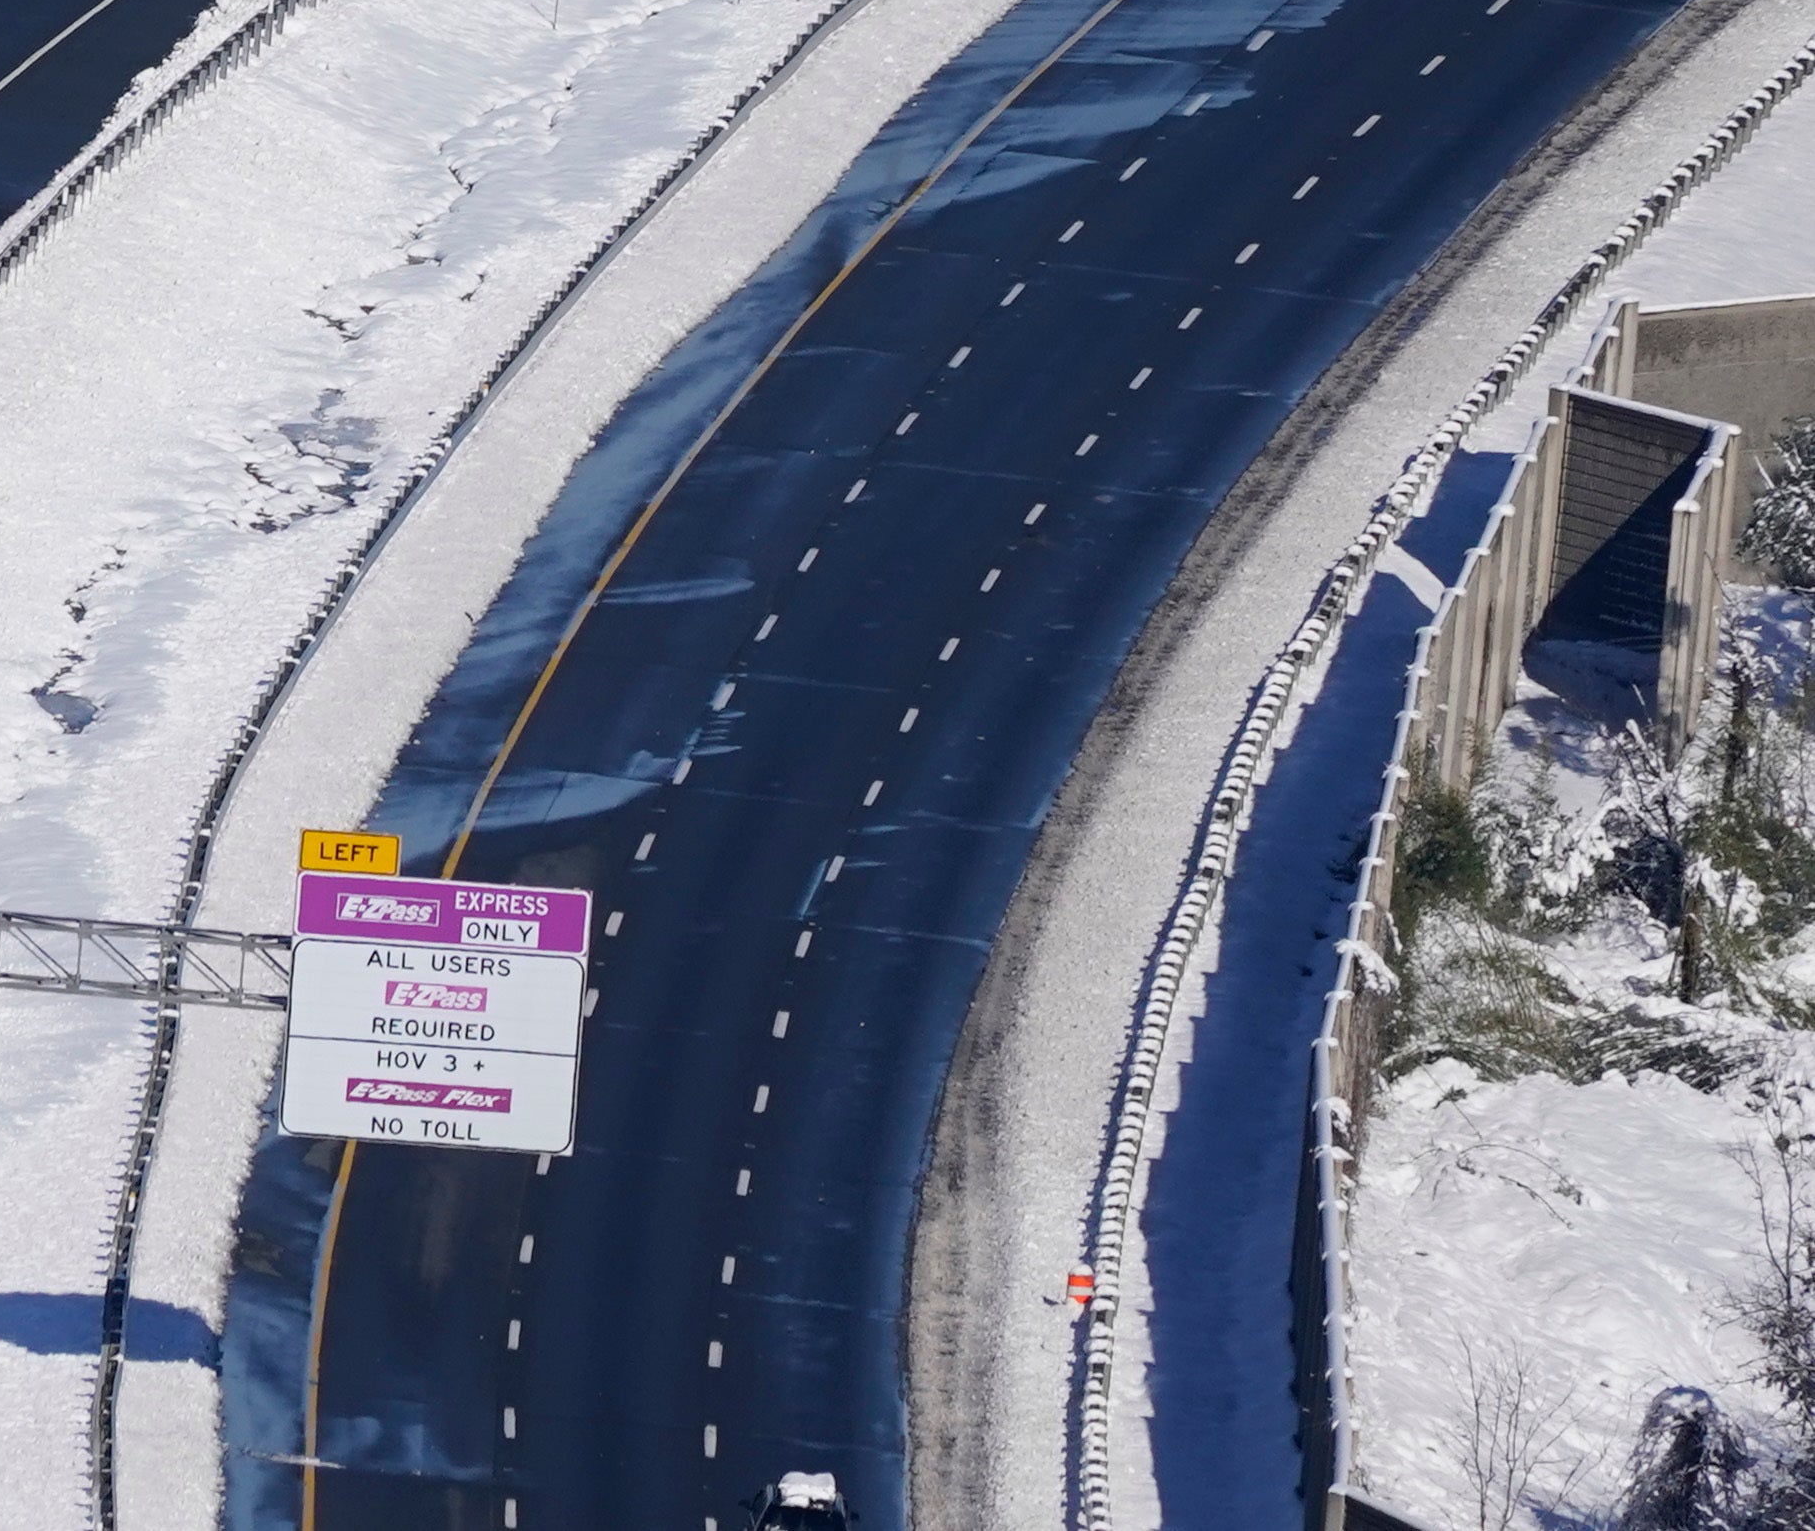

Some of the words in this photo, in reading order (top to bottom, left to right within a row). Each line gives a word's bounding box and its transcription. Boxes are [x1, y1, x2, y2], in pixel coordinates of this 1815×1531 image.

[319, 843, 379, 863] LEFT
[340, 897, 434, 923] E-ZPass
[455, 891, 549, 916] EXPRESS
[466, 922, 534, 943] ONLY
[366, 950, 414, 971] ALL
[431, 955, 511, 977] USERS
[389, 983, 484, 1010] E-ZPass
[372, 1018, 496, 1041] REQUIRED
[377, 1051, 427, 1071] HOV
[443, 1055, 457, 1071] 3
[473, 1060, 485, 1071] +
[442, 1088, 499, 1110] Flex
[371, 1117, 404, 1135] NO
[421, 1120, 481, 1141] TOLL
